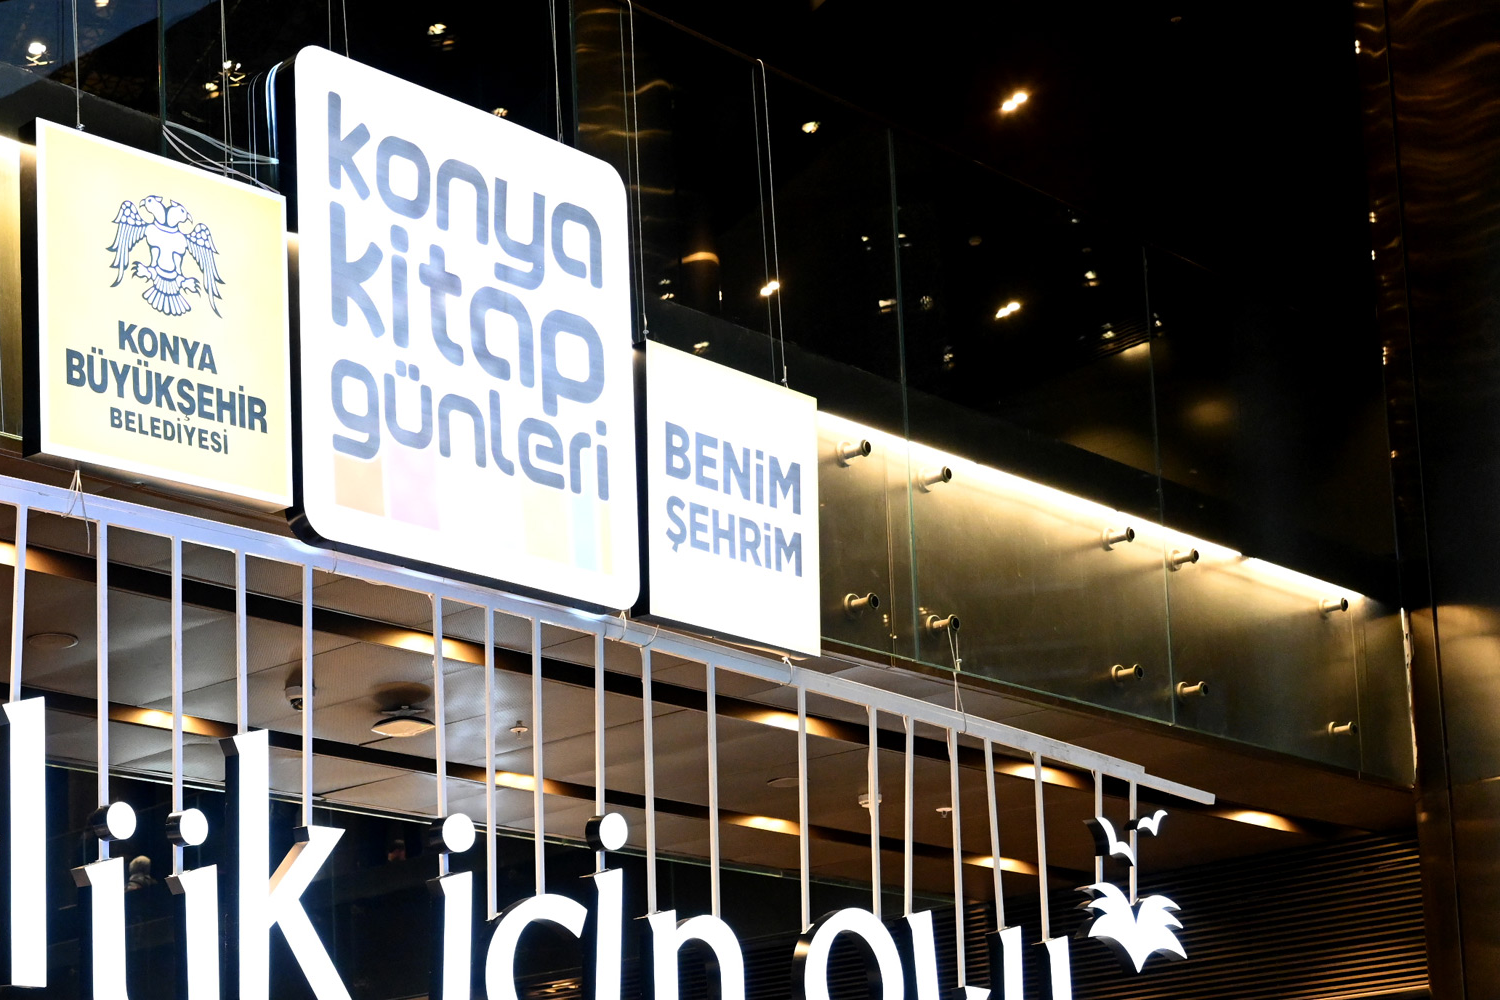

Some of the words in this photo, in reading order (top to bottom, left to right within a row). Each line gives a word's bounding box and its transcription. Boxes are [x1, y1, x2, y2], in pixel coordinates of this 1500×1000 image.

[328, 91, 603, 290] konya
[117, 320, 217, 375] KONYA
[329, 201, 605, 418] kitap
[65, 347, 268, 434] BÜYÜKŞEHİR
[109, 406, 230, 456] BELEDİYESİ
[331, 358, 609, 501] günleri
[664, 423, 802, 515] BENİM
[666, 496, 802, 579] ŞEHRİM
